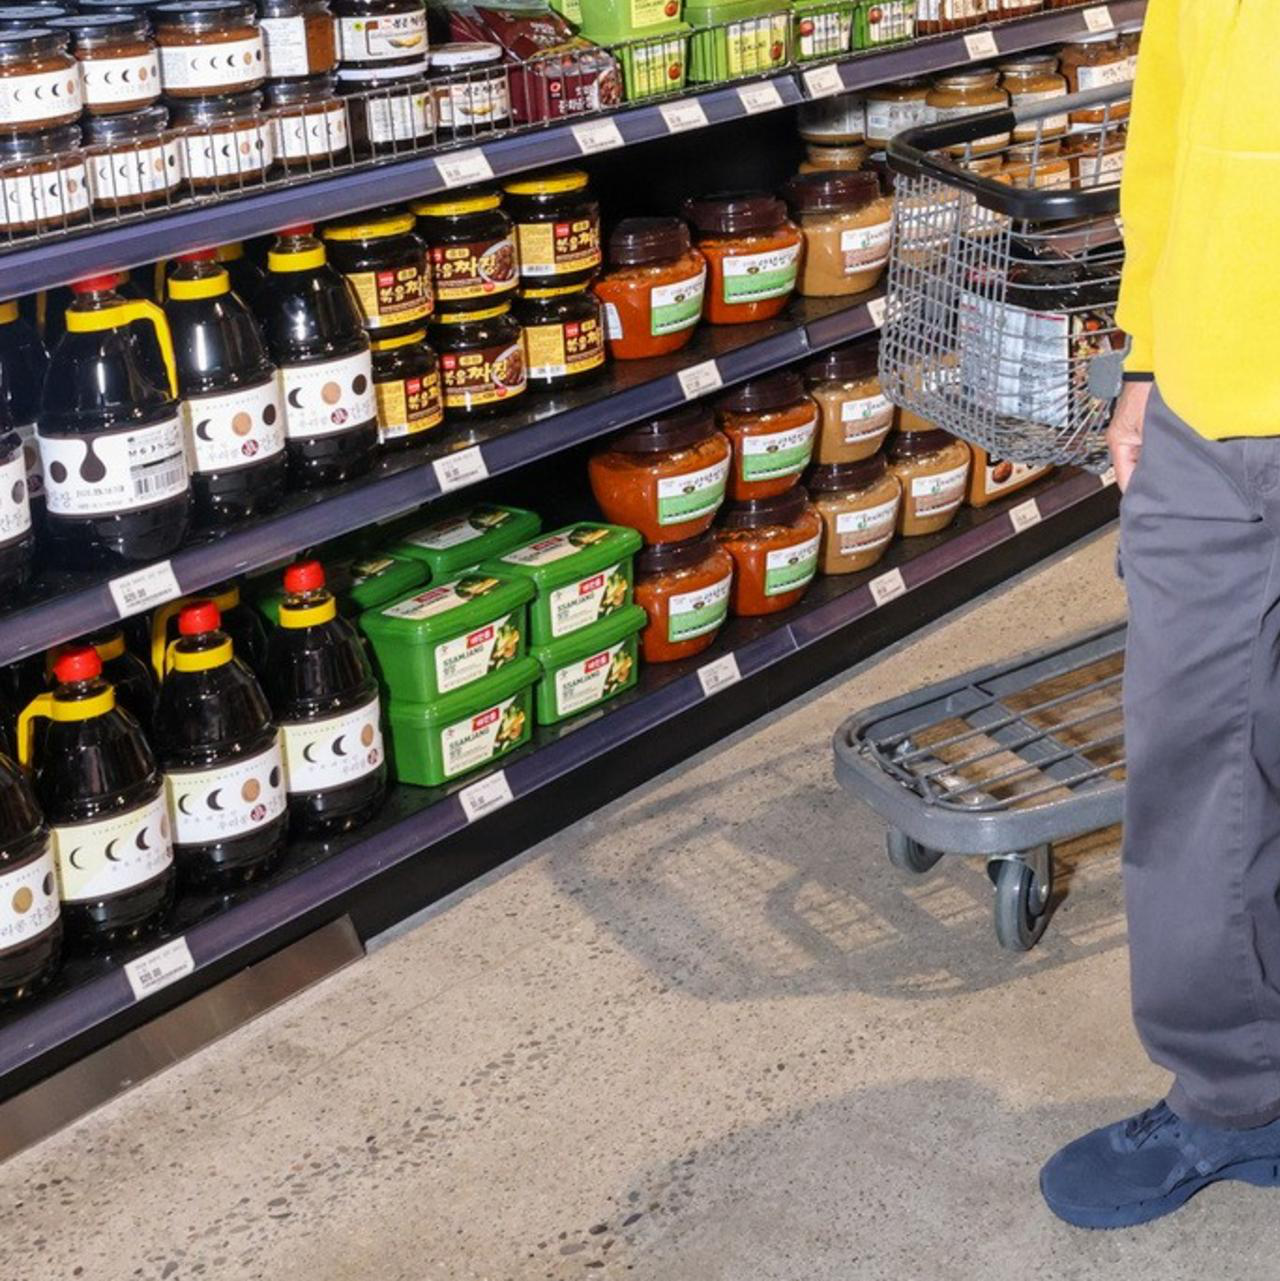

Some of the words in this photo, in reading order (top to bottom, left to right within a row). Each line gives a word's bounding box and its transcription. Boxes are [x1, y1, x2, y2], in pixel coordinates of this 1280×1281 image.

[557, 593, 595, 612] SSAMJANG
[442, 646, 485, 667] SSAMJANG
[562, 670, 601, 690] SSAMJANG
[449, 728, 490, 749] SSAMJANG
